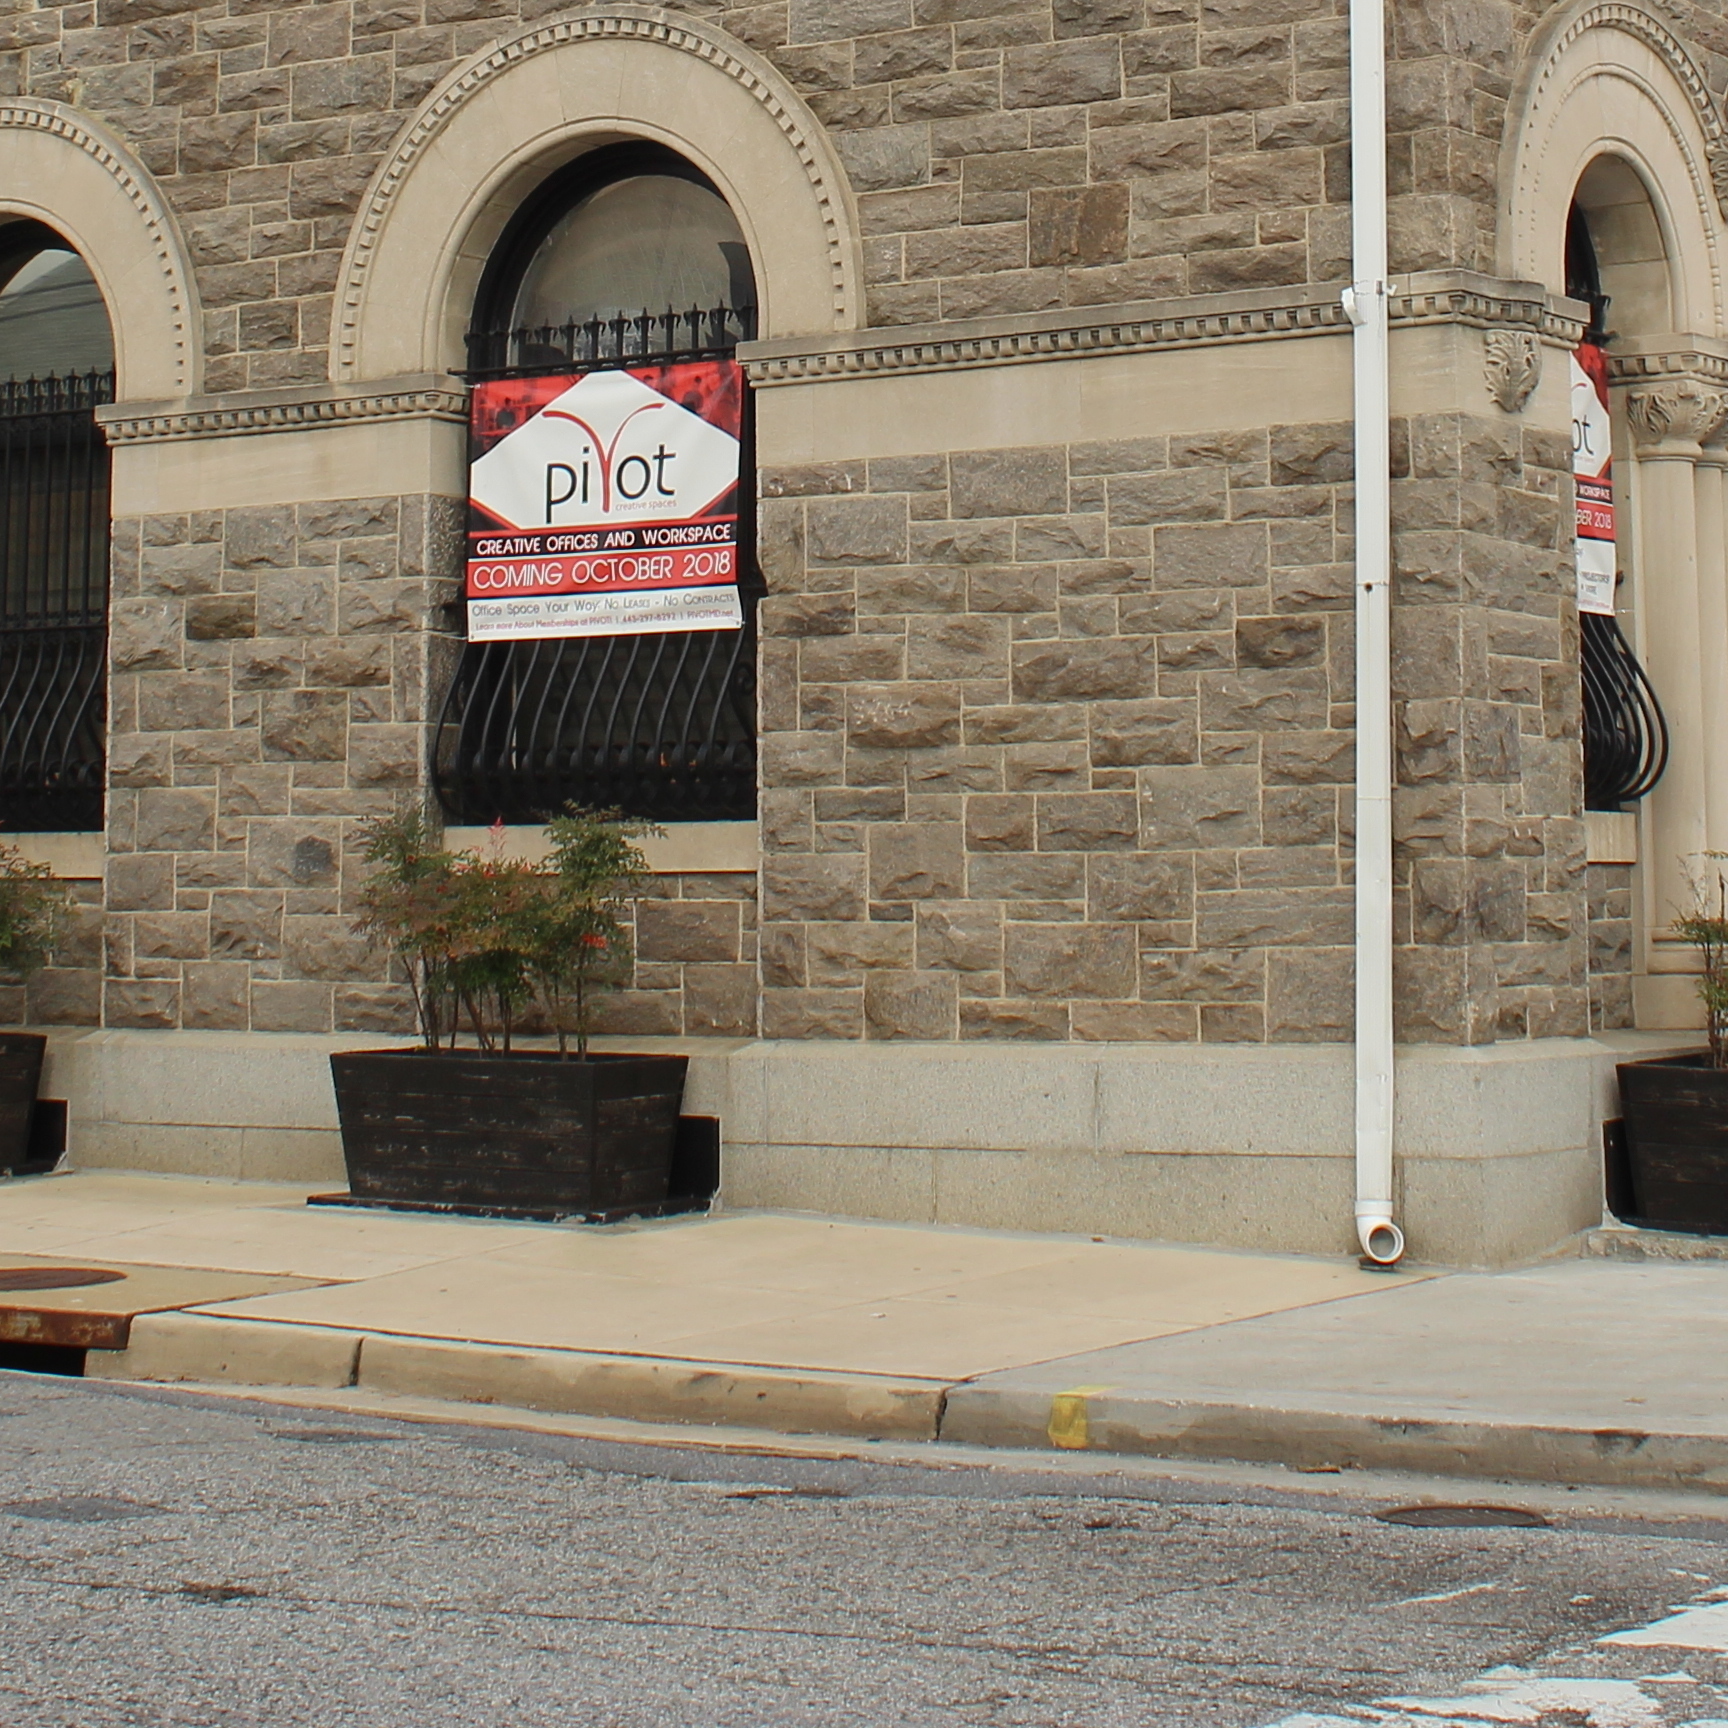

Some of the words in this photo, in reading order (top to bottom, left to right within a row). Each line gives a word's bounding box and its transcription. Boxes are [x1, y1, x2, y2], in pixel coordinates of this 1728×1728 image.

[542, 402, 677, 524] pivot
[615, 501, 646, 511] creative
[648, 499, 677, 511] spaces
[1594, 511, 1612, 529] 2018
[476, 536, 541, 555] CREATIVE
[546, 533, 599, 552] OFFICES
[604, 530, 635, 548] AND
[642, 523, 731, 545] WORKSPACE
[473, 561, 563, 590] COMING
[572, 555, 673, 584] OCTOBER
[682, 550, 731, 578] 2018
[472, 604, 503, 617] Office
[506, 602, 541, 617] Space
[545, 600, 570, 613] Your
